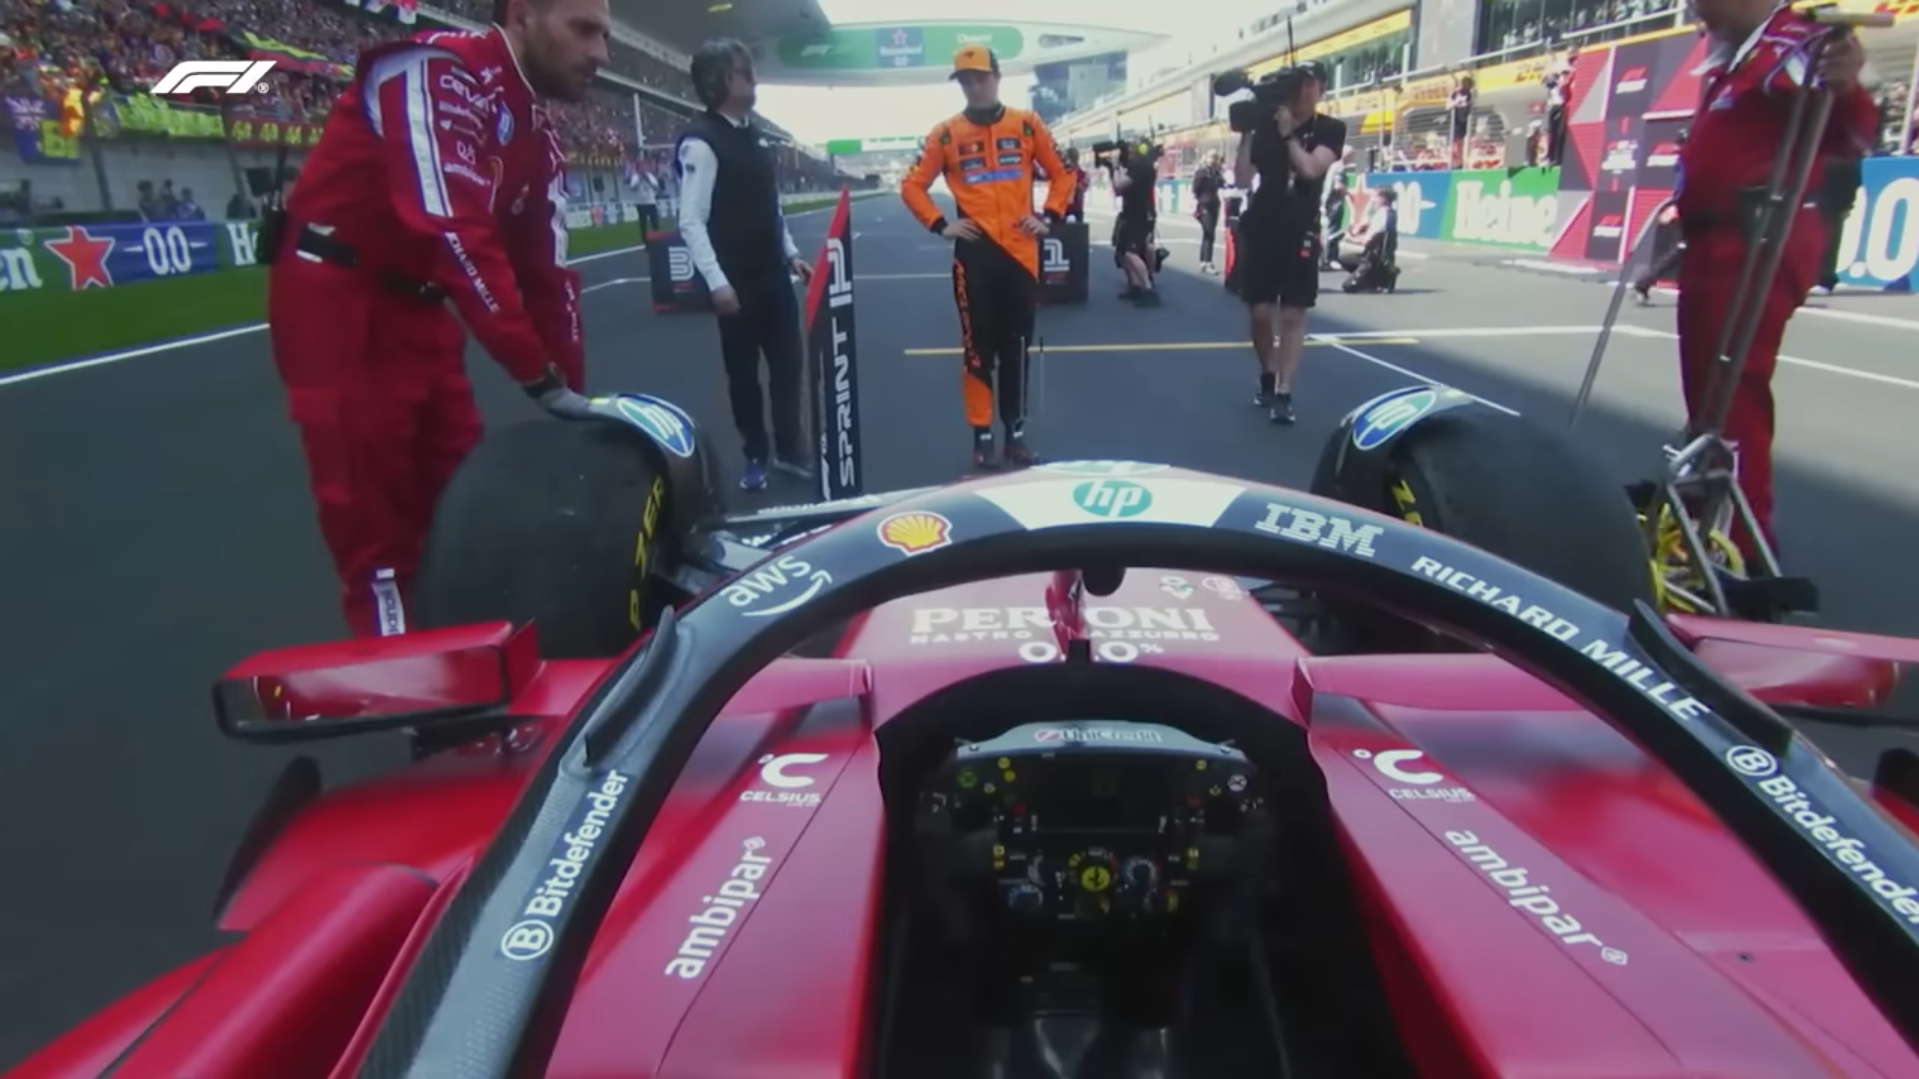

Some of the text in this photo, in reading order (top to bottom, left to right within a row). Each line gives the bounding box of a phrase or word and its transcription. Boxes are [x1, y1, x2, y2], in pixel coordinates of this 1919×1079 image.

[831, 317, 855, 489] SPRINT
[1082, 480, 1144, 518] hp
[1254, 502, 1385, 558] IBM
[720, 555, 812, 607] aws
[910, 629, 1033, 645] NASTRO
[911, 605, 1216, 634] PERONI
[1411, 555, 1711, 721] RICHARD MILLE
[739, 790, 821, 803] CELSIUS
[1388, 787, 1475, 803] CELSIUS
[523, 769, 628, 919] Bitdefender
